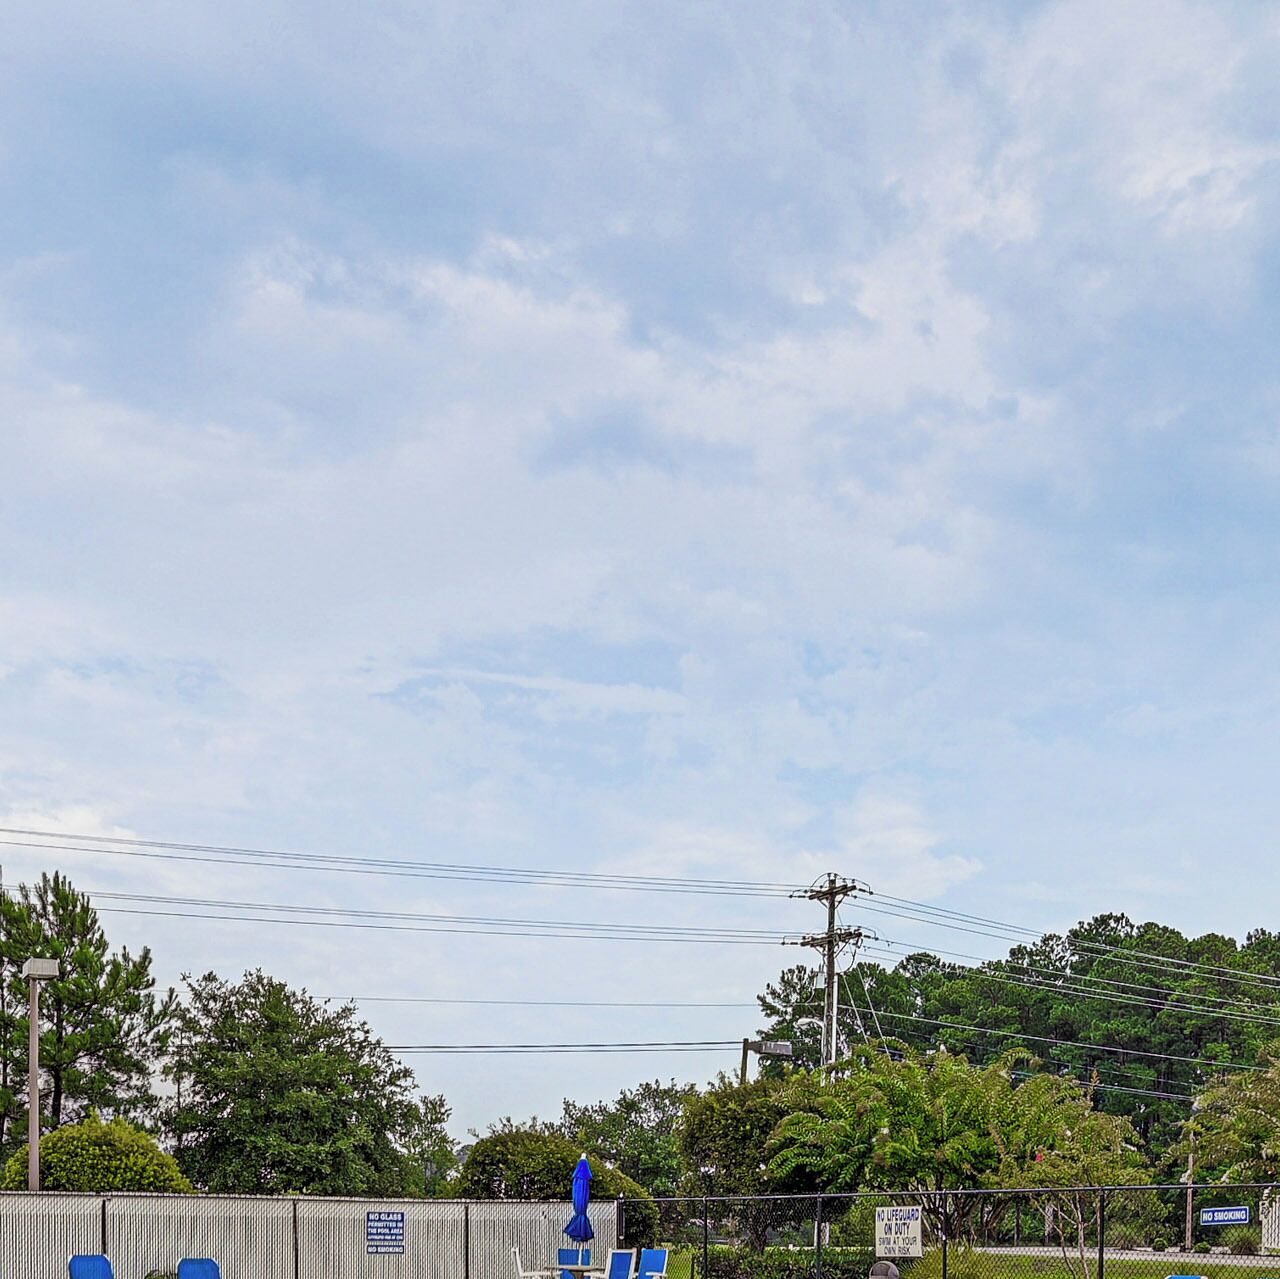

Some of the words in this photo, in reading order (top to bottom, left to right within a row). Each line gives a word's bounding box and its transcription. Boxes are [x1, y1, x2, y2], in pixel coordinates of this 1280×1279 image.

[369, 1213, 379, 1221] NO
[380, 1213, 402, 1221] GLASS
[876, 1209, 885, 1222] NO
[887, 1208, 920, 1221] LIFEGUARD
[1202, 1211, 1213, 1221] NO
[1214, 1210, 1246, 1221] SMOKING
[884, 1223, 893, 1236] ON
[895, 1222, 911, 1236] DUTY
[879, 1237, 891, 1246] SWIM
[893, 1236, 900, 1246] AT
[902, 1236, 917, 1246] YOUR
[884, 1246, 896, 1255] OWN
[898, 1246, 911, 1255] RISK
